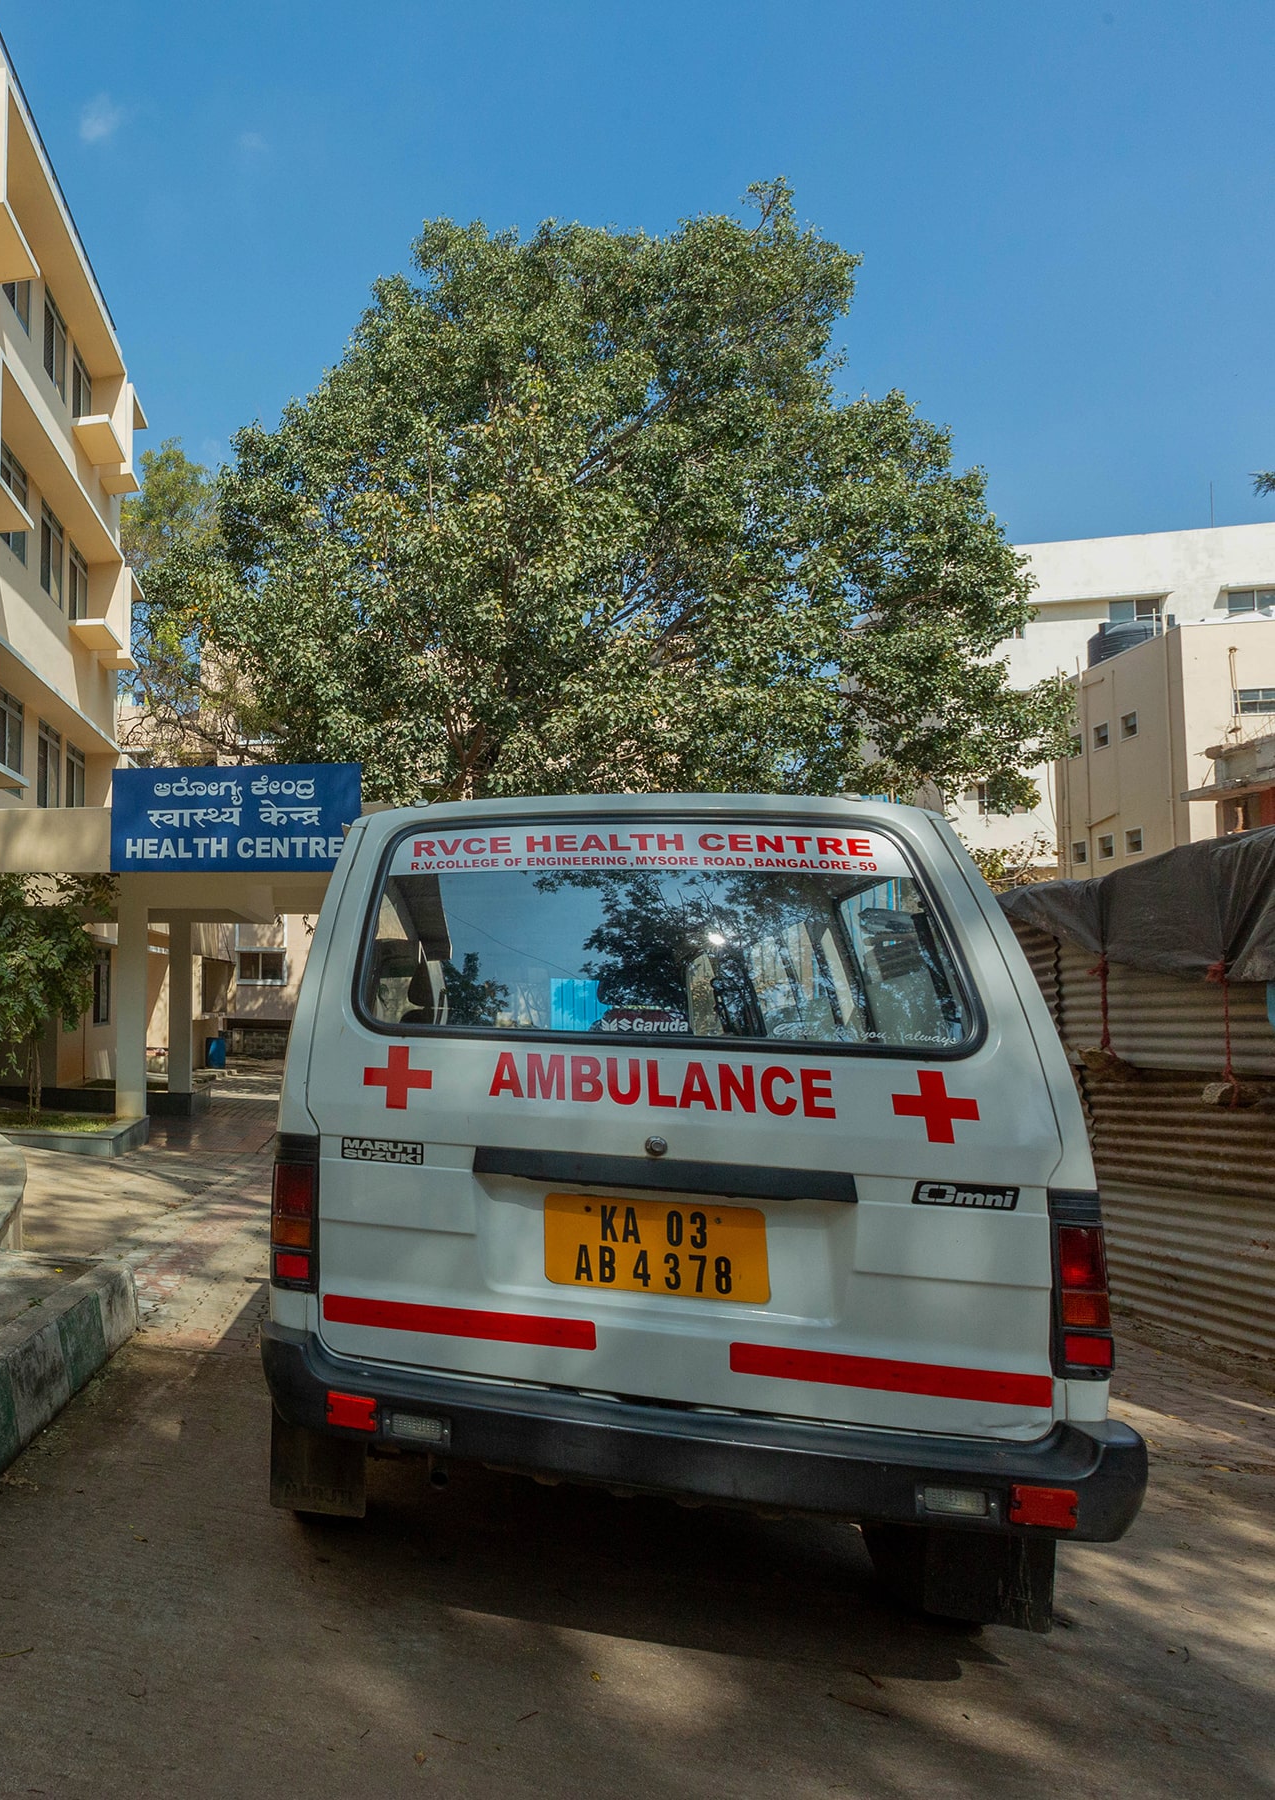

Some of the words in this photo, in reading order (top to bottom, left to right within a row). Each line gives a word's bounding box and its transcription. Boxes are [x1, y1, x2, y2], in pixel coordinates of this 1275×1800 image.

[154, 776, 243, 806] ಆರೋಗ್ಯ
[251, 775, 315, 800] ಕೇಂದ್ರ
[147, 807, 242, 829] स्वास्थ्य
[258, 800, 322, 827] केन्द्र
[125, 837, 228, 859] HEALTH
[236, 836, 345, 859] CENTRE
[413, 836, 512, 858] RVCE
[526, 833, 684, 853] HEALTH
[698, 833, 874, 858] CENTRE
[504, 857, 522, 867] OF
[632, 1017, 689, 1033] Garuda
[904, 1030, 958, 1046] always
[489, 1051, 837, 1120] AMBULANCE
[343, 1138, 422, 1154] MARUTI
[343, 1148, 422, 1164] SUZUKI
[918, 1183, 1015, 1208] Omni
[600, 1204, 642, 1244] KA
[666, 1210, 707, 1249] 03
[575, 1244, 616, 1283] AB
[633, 1250, 732, 1295] 4378
